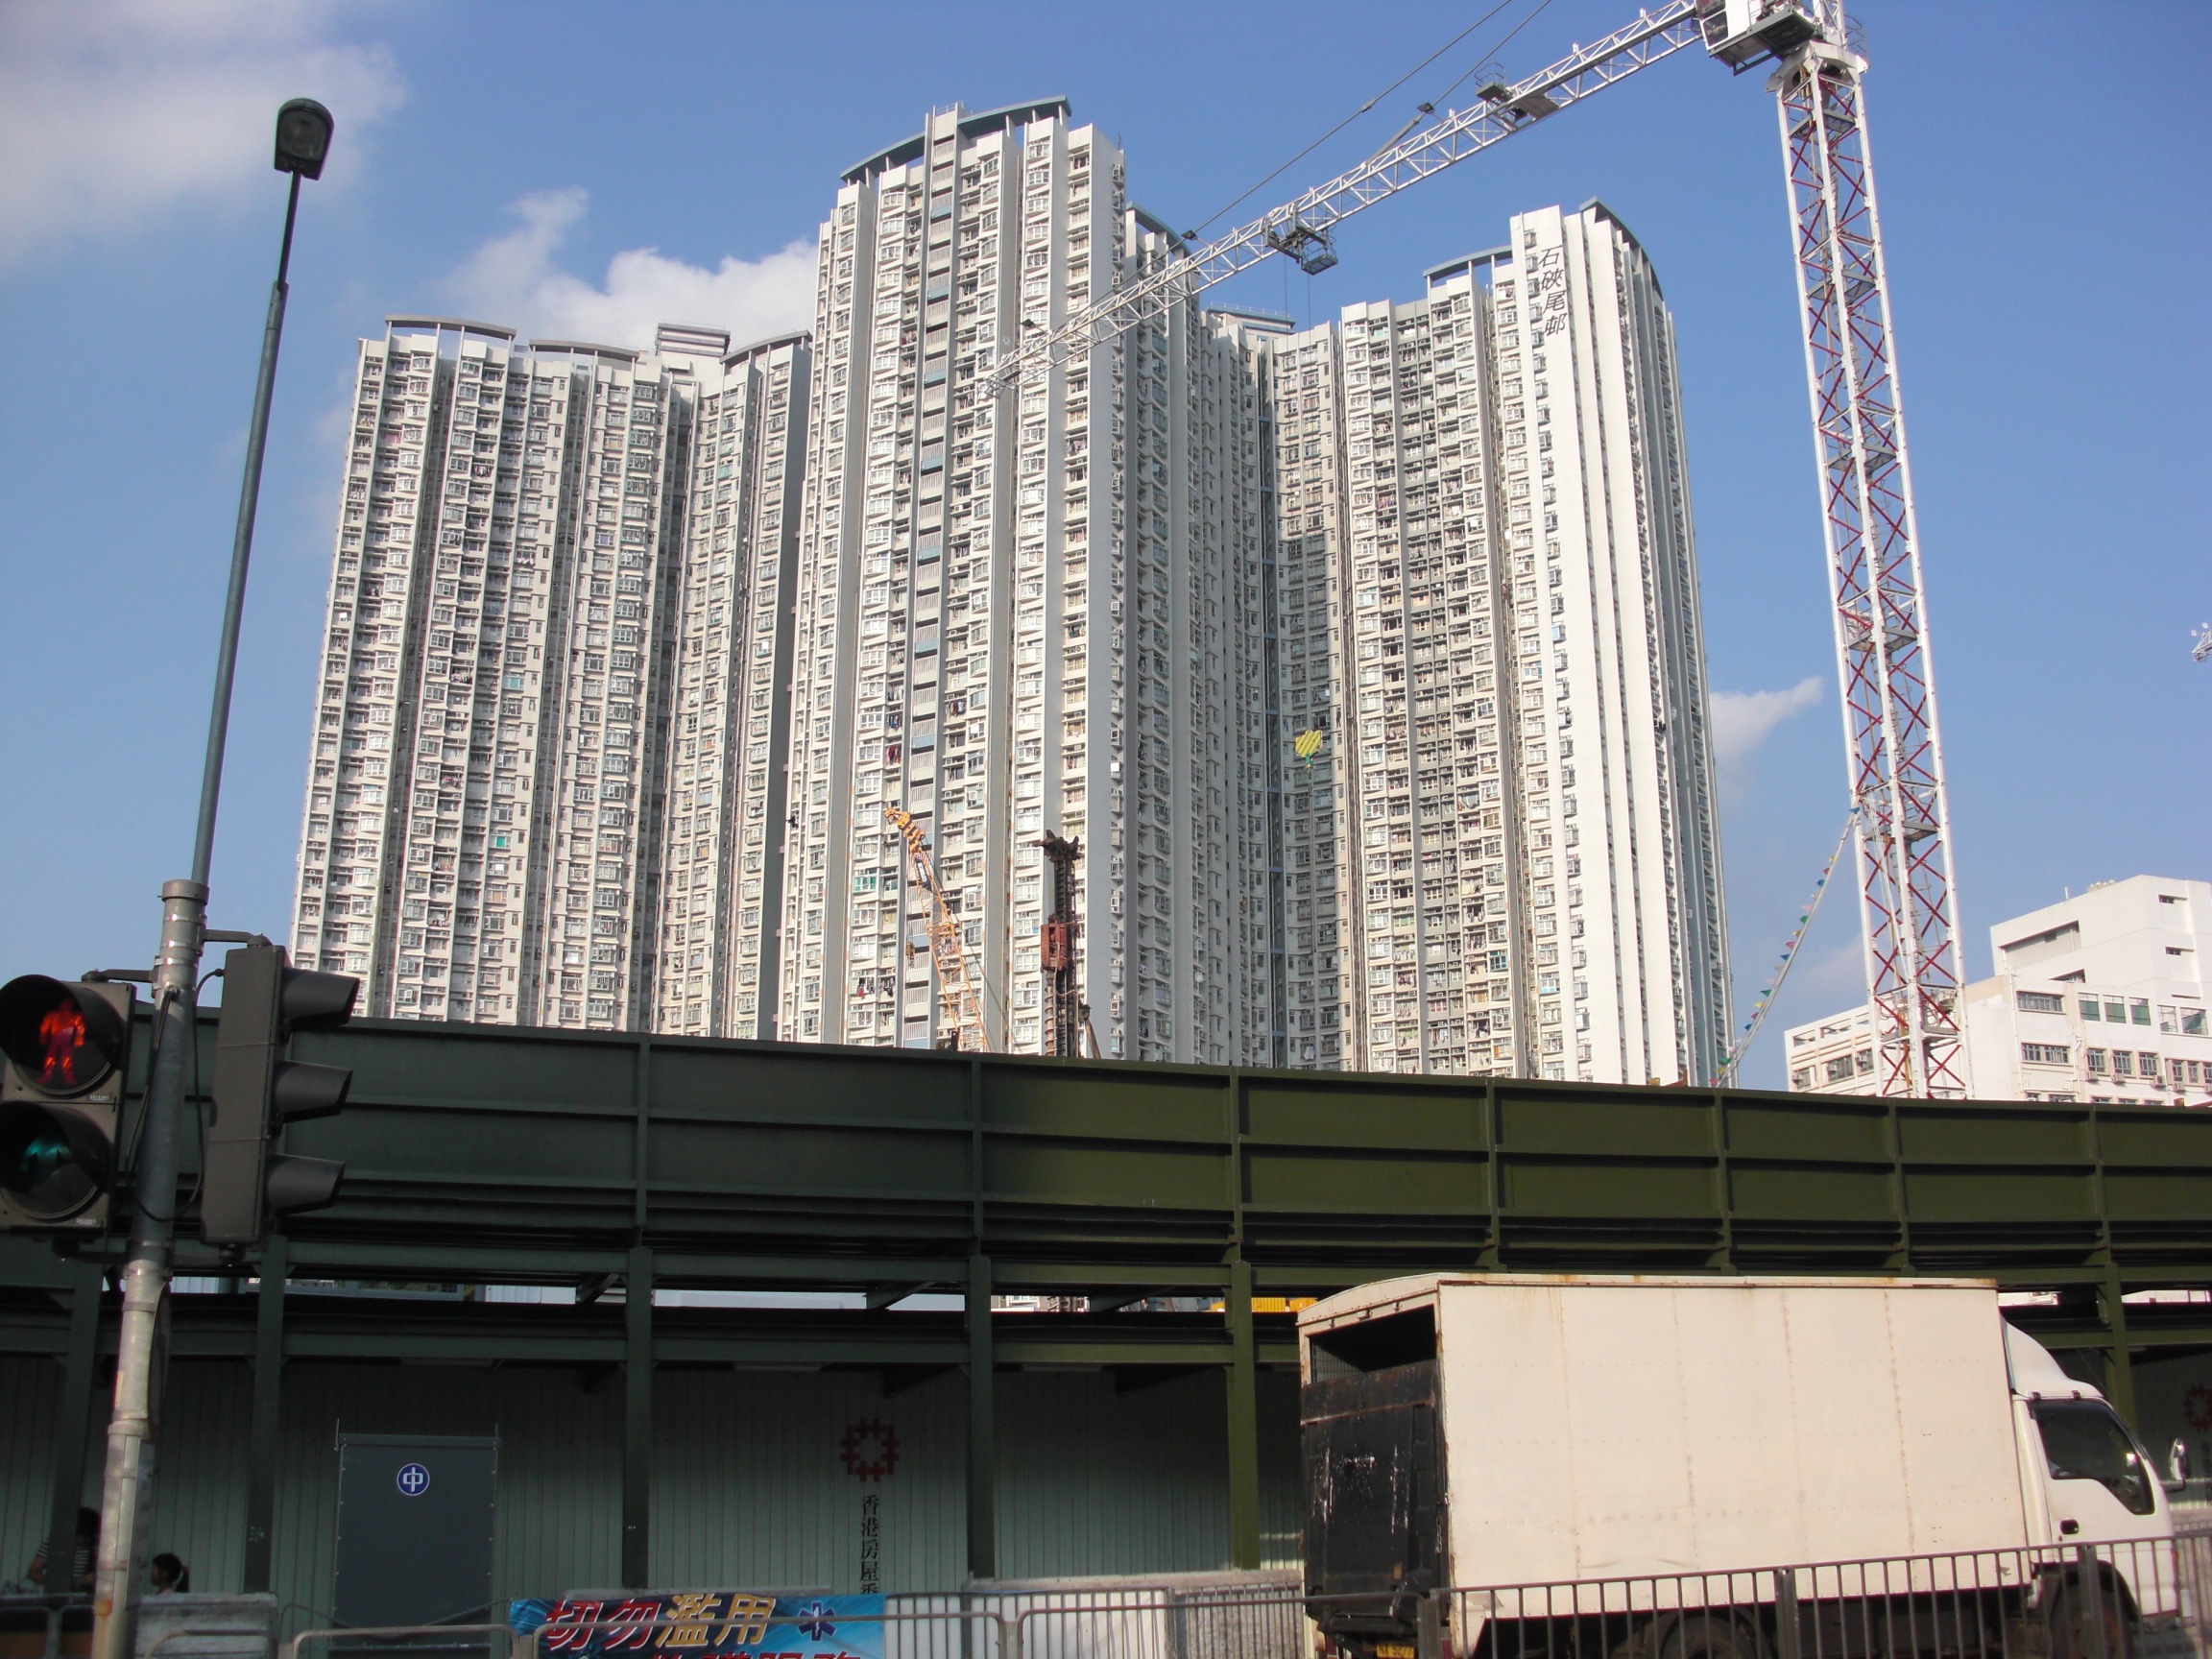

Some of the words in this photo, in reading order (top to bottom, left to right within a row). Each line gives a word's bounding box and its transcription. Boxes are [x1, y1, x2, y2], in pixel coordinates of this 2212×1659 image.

[1538, 245, 1568, 336] 石硤尾邨
[545, 1593, 776, 1650] 切勿濫用
